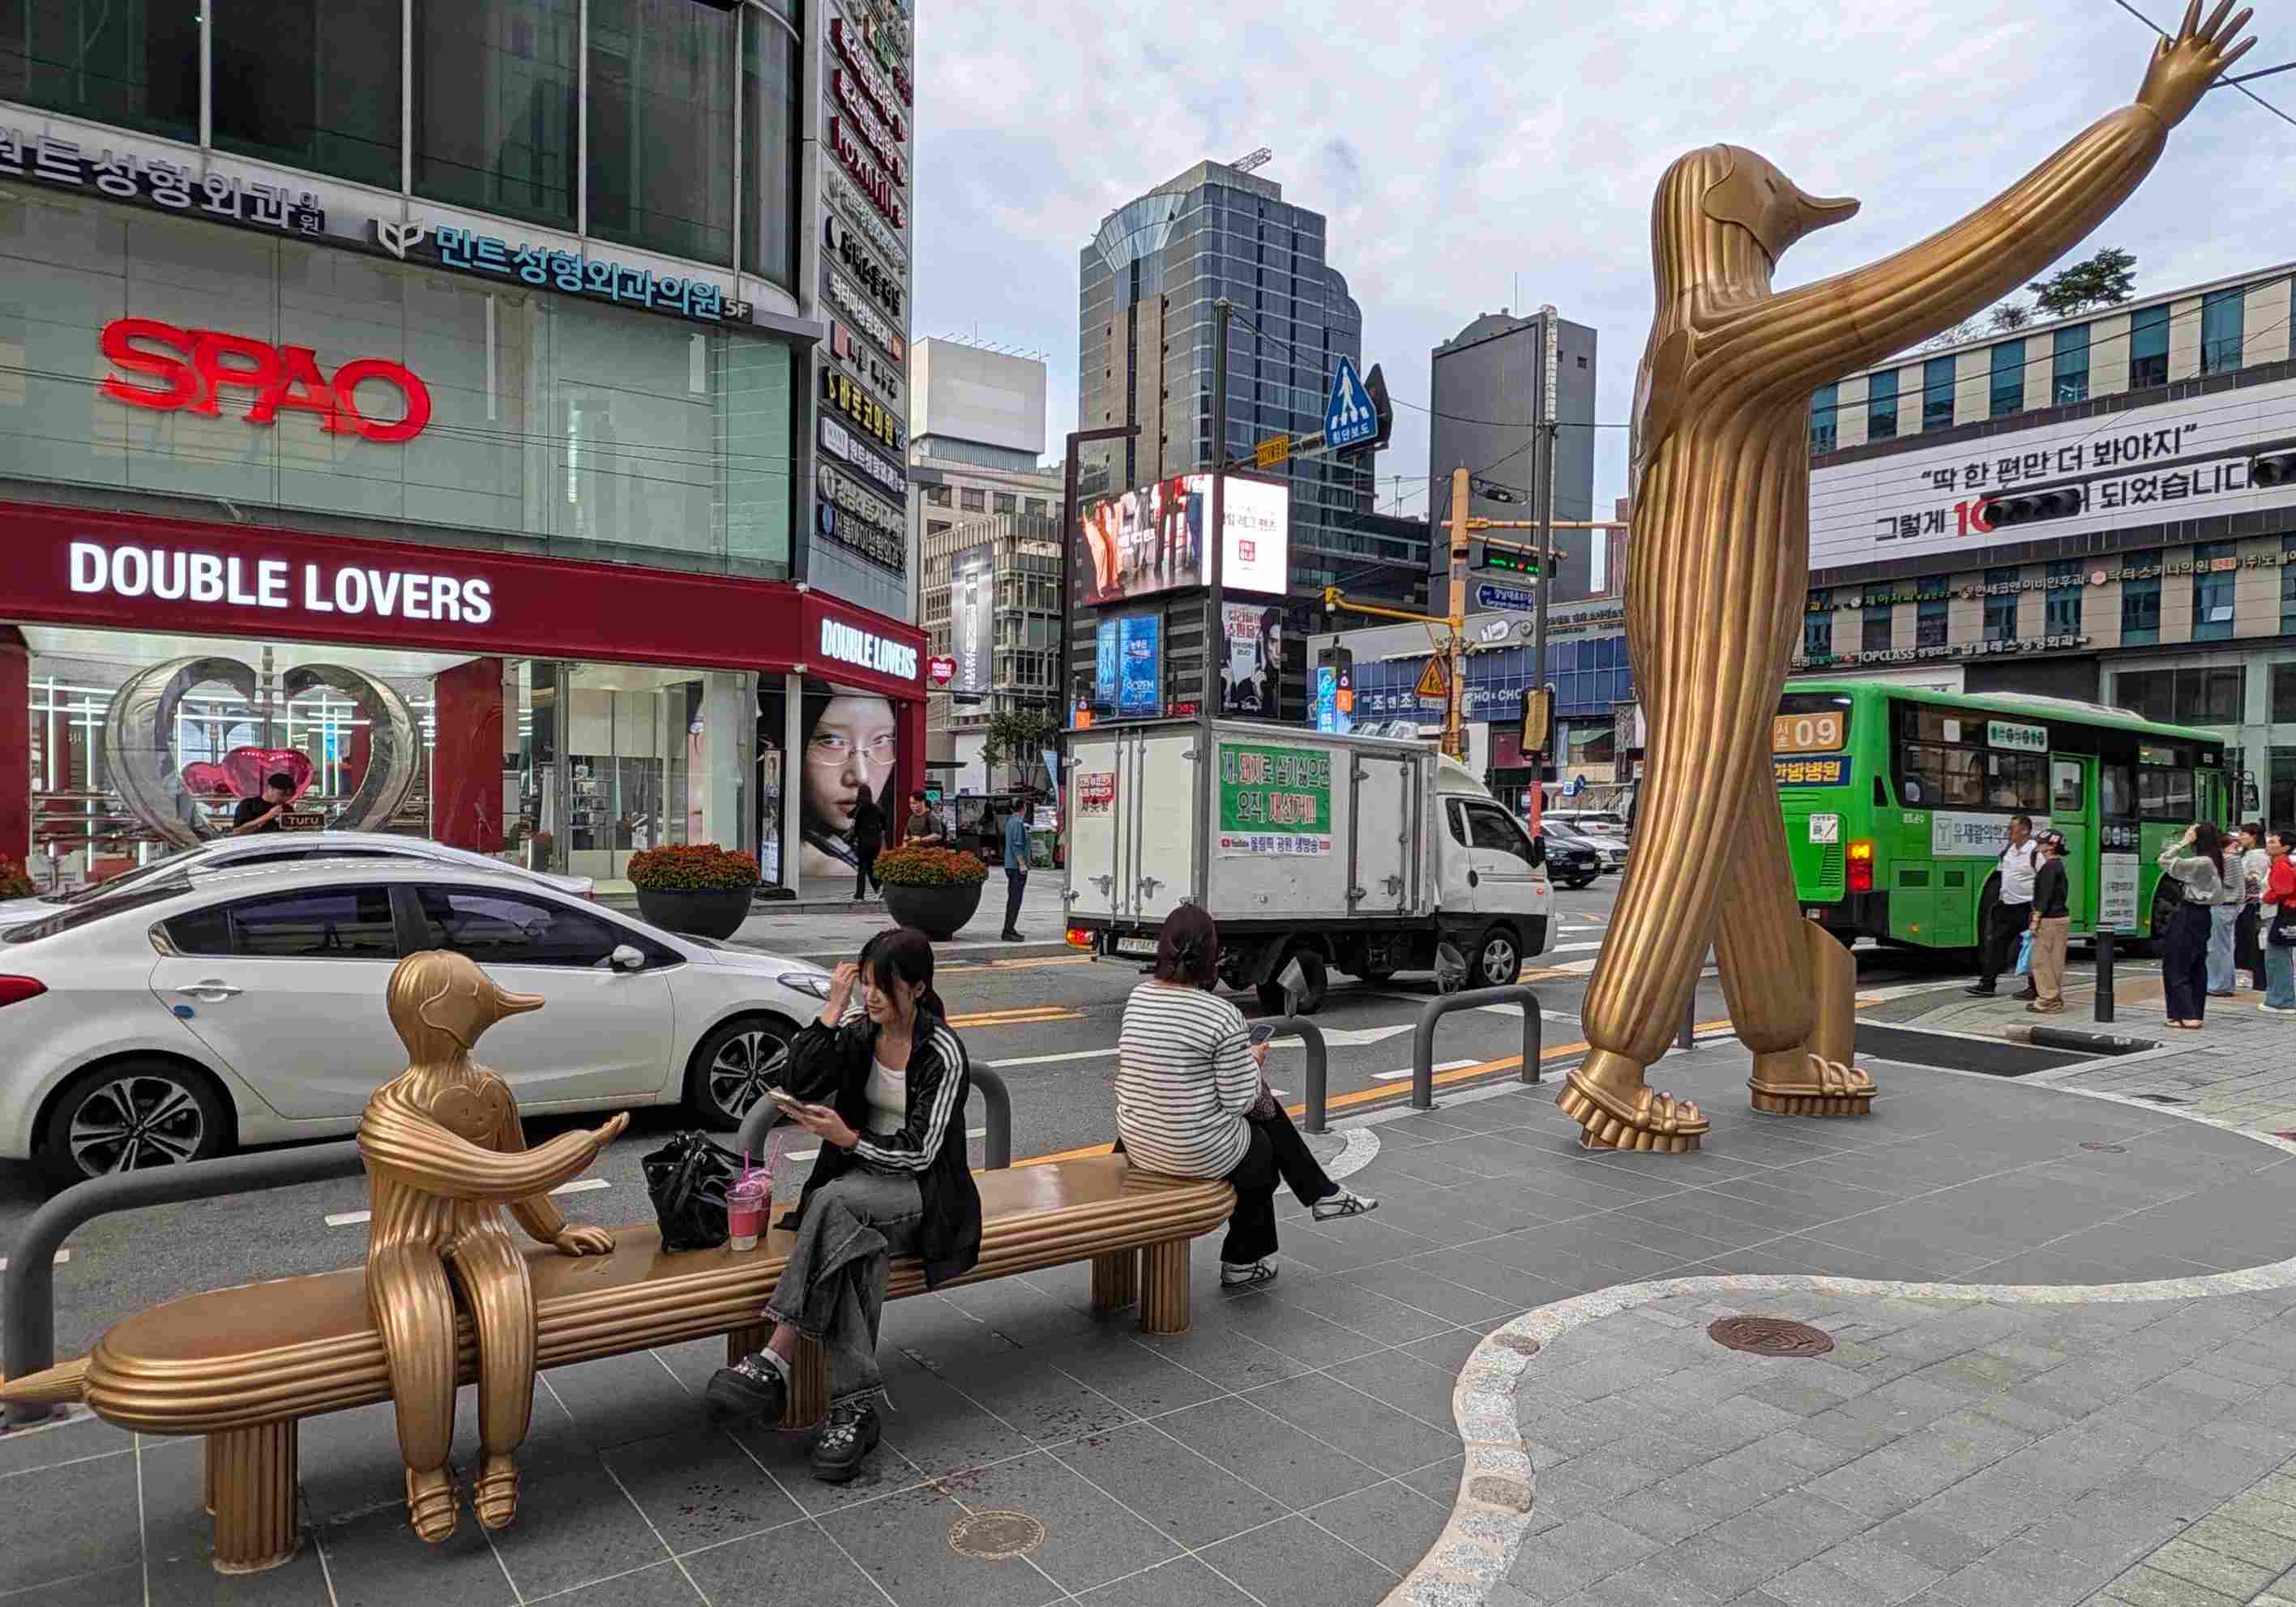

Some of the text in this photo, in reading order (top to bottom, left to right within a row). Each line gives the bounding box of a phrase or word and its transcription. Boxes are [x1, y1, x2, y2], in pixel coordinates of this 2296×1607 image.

[437, 225, 749, 320] 민트성형외과의원 5F
[100, 318, 431, 444] SPAO
[1965, 463, 1989, 489] 한
[1997, 449, 2049, 484] 편만
[2058, 445, 2084, 472] 더
[1875, 510, 1945, 541] 그렇게
[70, 542, 492, 623] DOUBLE LOVERS
[822, 618, 917, 680] DOUBLE LOVERS
[1858, 648, 1915, 662] TOPCLASS
[1795, 718, 1836, 746] 09
